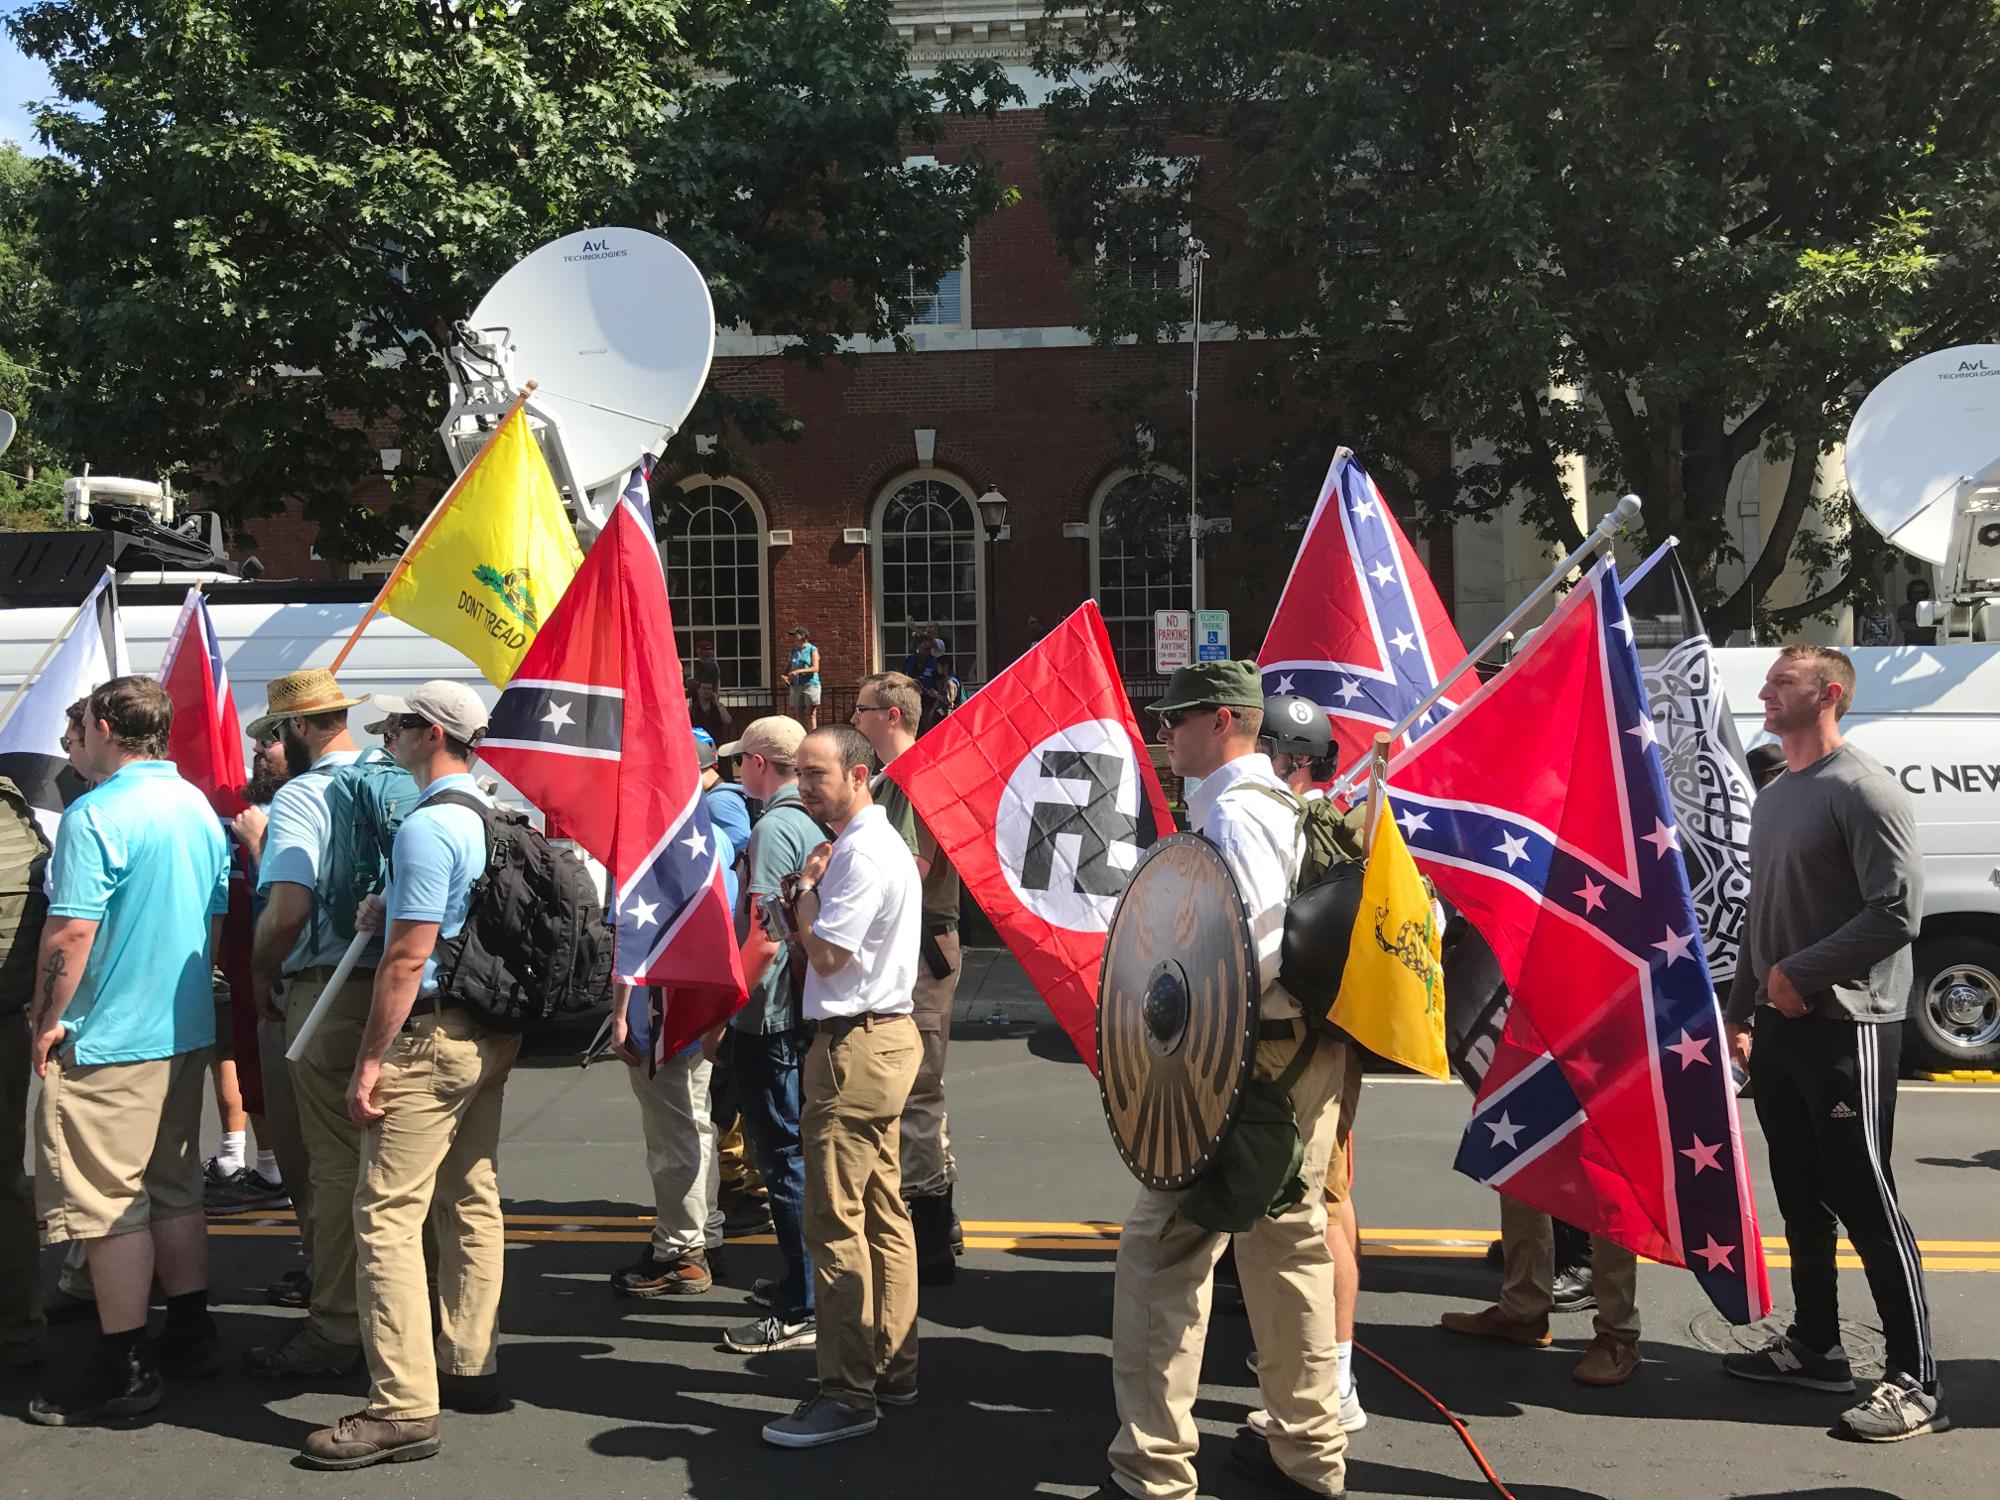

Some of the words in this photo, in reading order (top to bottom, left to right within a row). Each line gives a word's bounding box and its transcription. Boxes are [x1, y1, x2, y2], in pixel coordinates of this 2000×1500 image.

[582, 239, 610, 252] AvL
[563, 250, 628, 262] TECHNOLOGIES
[1958, 360, 1989, 371] AvL
[457, 590, 484, 622] DONT
[483, 608, 527, 650] TREAD
[1167, 616, 1179, 627] NO
[1202, 622, 1223, 630] PARKING
[1158, 629, 1187, 640] PARKING
[1294, 703, 1308, 721] 8
[1768, 1349, 1802, 1372] N
